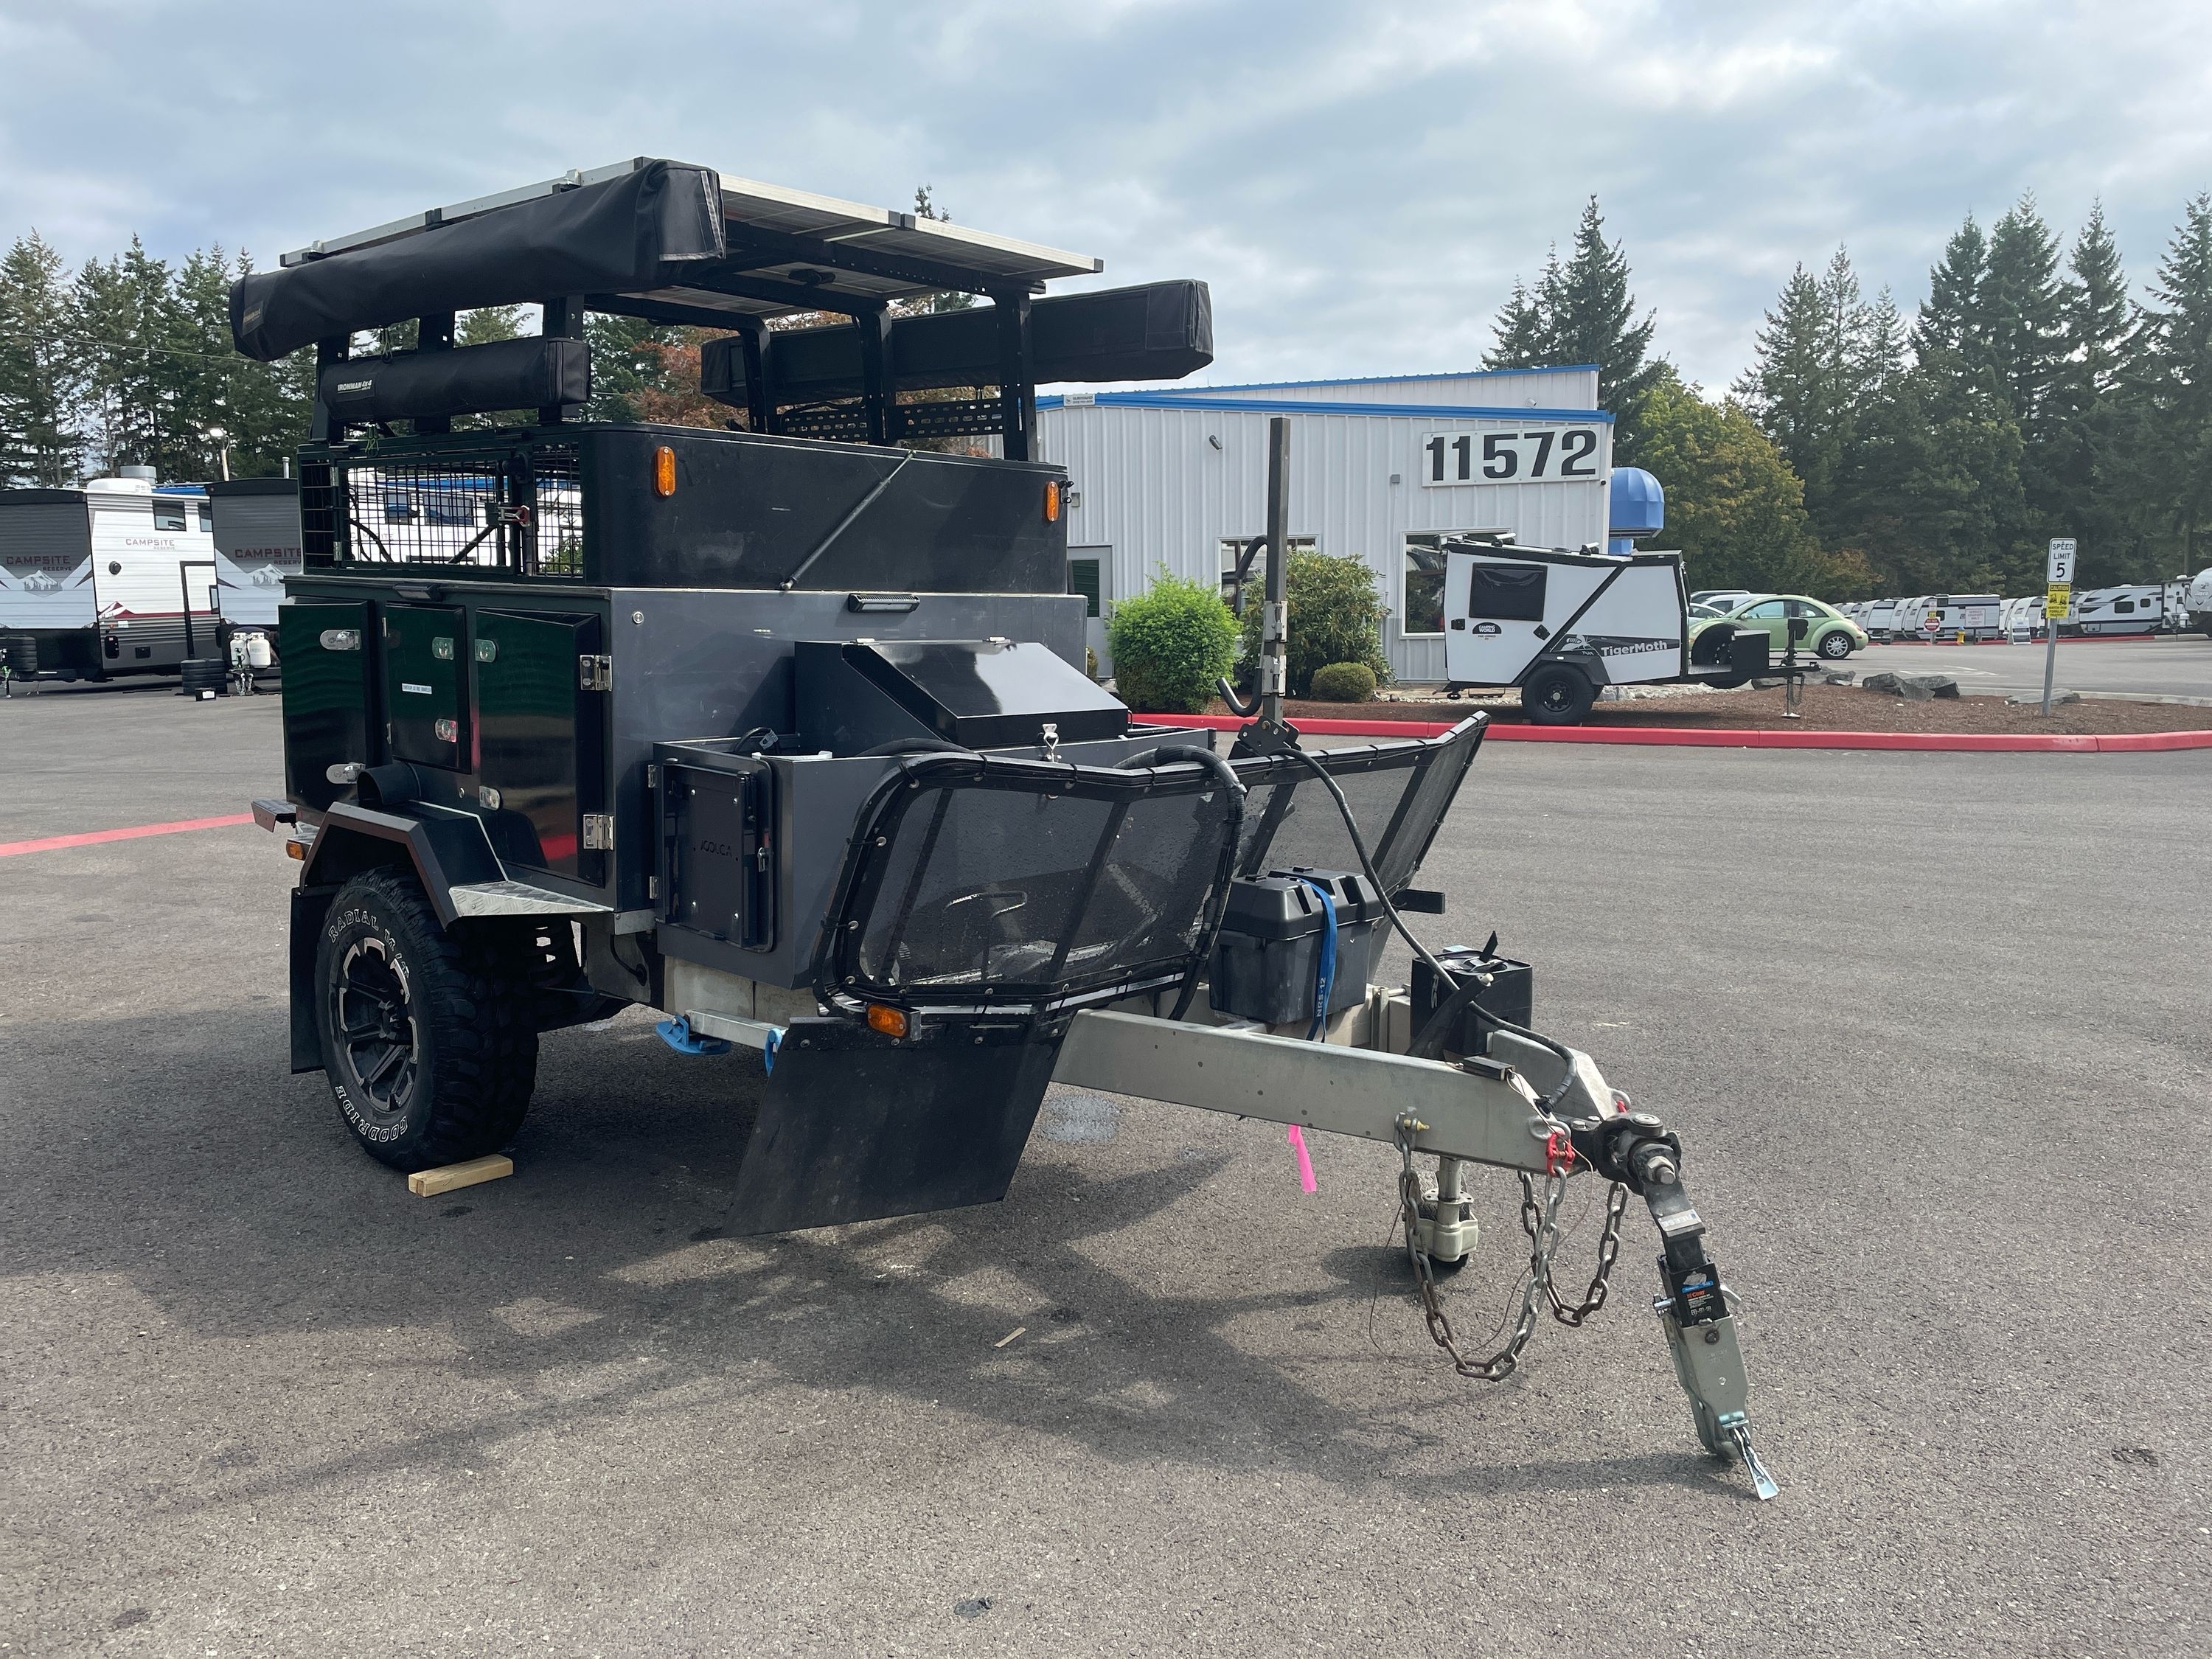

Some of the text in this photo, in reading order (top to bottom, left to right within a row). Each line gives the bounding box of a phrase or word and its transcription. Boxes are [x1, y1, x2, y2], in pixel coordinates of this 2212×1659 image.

[337, 381, 362, 392] IRONMAN
[1426, 430, 1597, 481] 11572
[125, 538, 175, 546] CAMPSITE
[6, 555, 71, 565] CAMPSITE
[2056, 562, 2065, 578] 5
[1601, 640, 1668, 656] TigerMoth
[328, 909, 379, 943] RADIAL
[1316, 977, 1326, 1018] NRS-12
[335, 1085, 408, 1142] GOODRIDE
